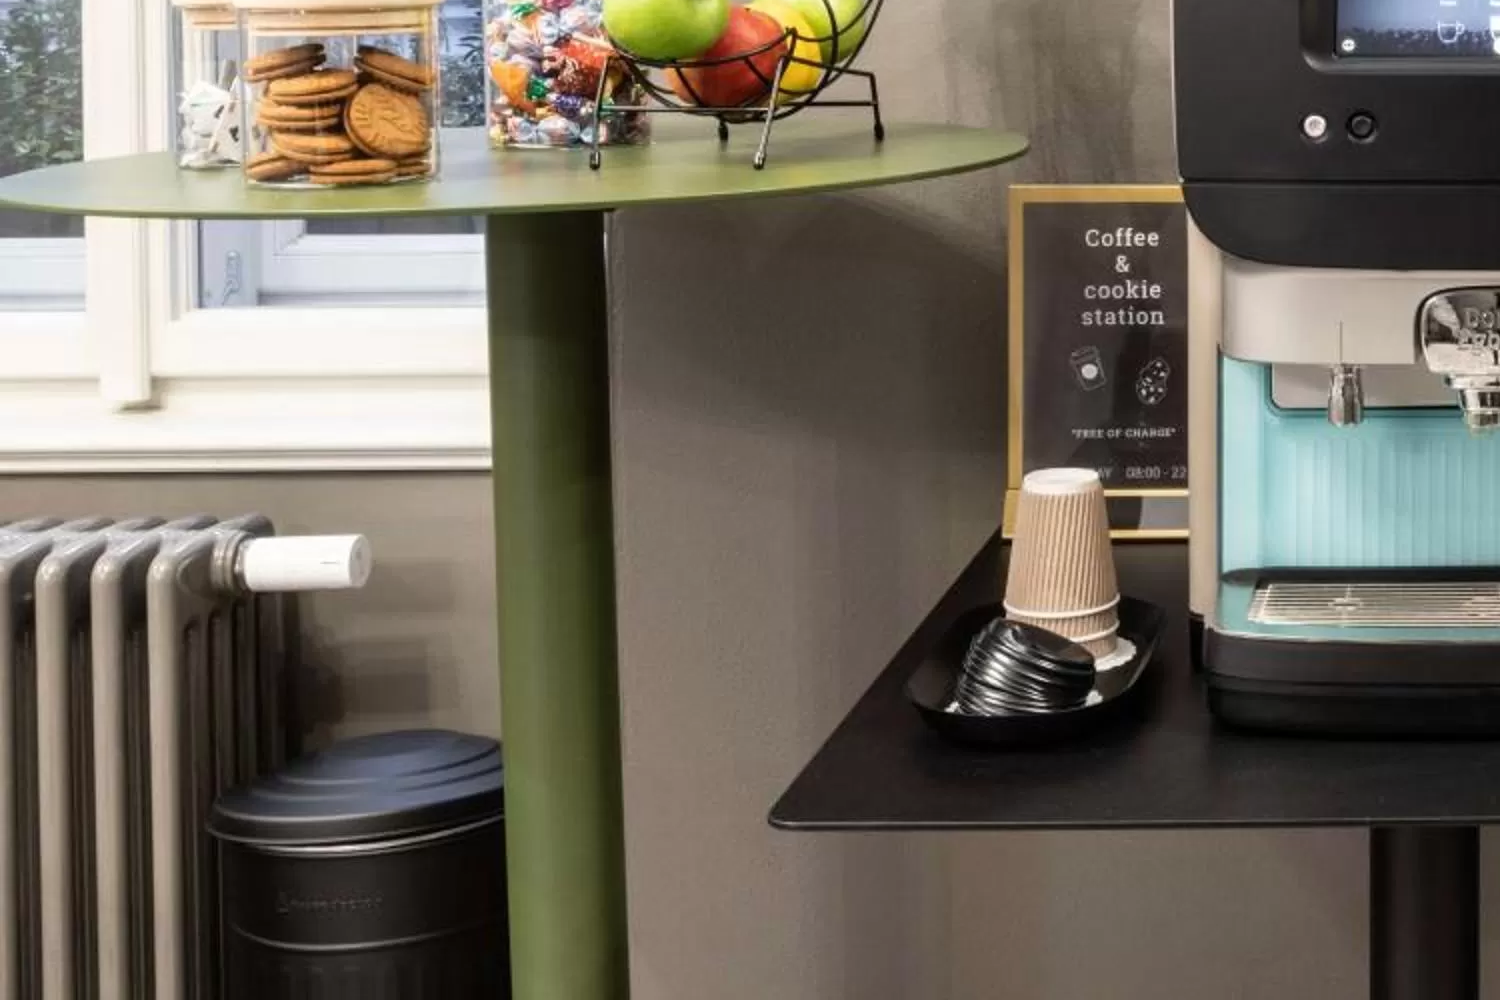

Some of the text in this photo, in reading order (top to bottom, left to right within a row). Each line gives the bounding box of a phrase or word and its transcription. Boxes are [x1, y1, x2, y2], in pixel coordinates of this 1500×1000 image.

[1085, 228, 1160, 247] Coffee
[1115, 255, 1130, 273] &
[1084, 280, 1162, 299] cookie
[1081, 306, 1165, 326] station
[1106, 429, 1121, 438] OF
[1125, 466, 1161, 479] 08:00
